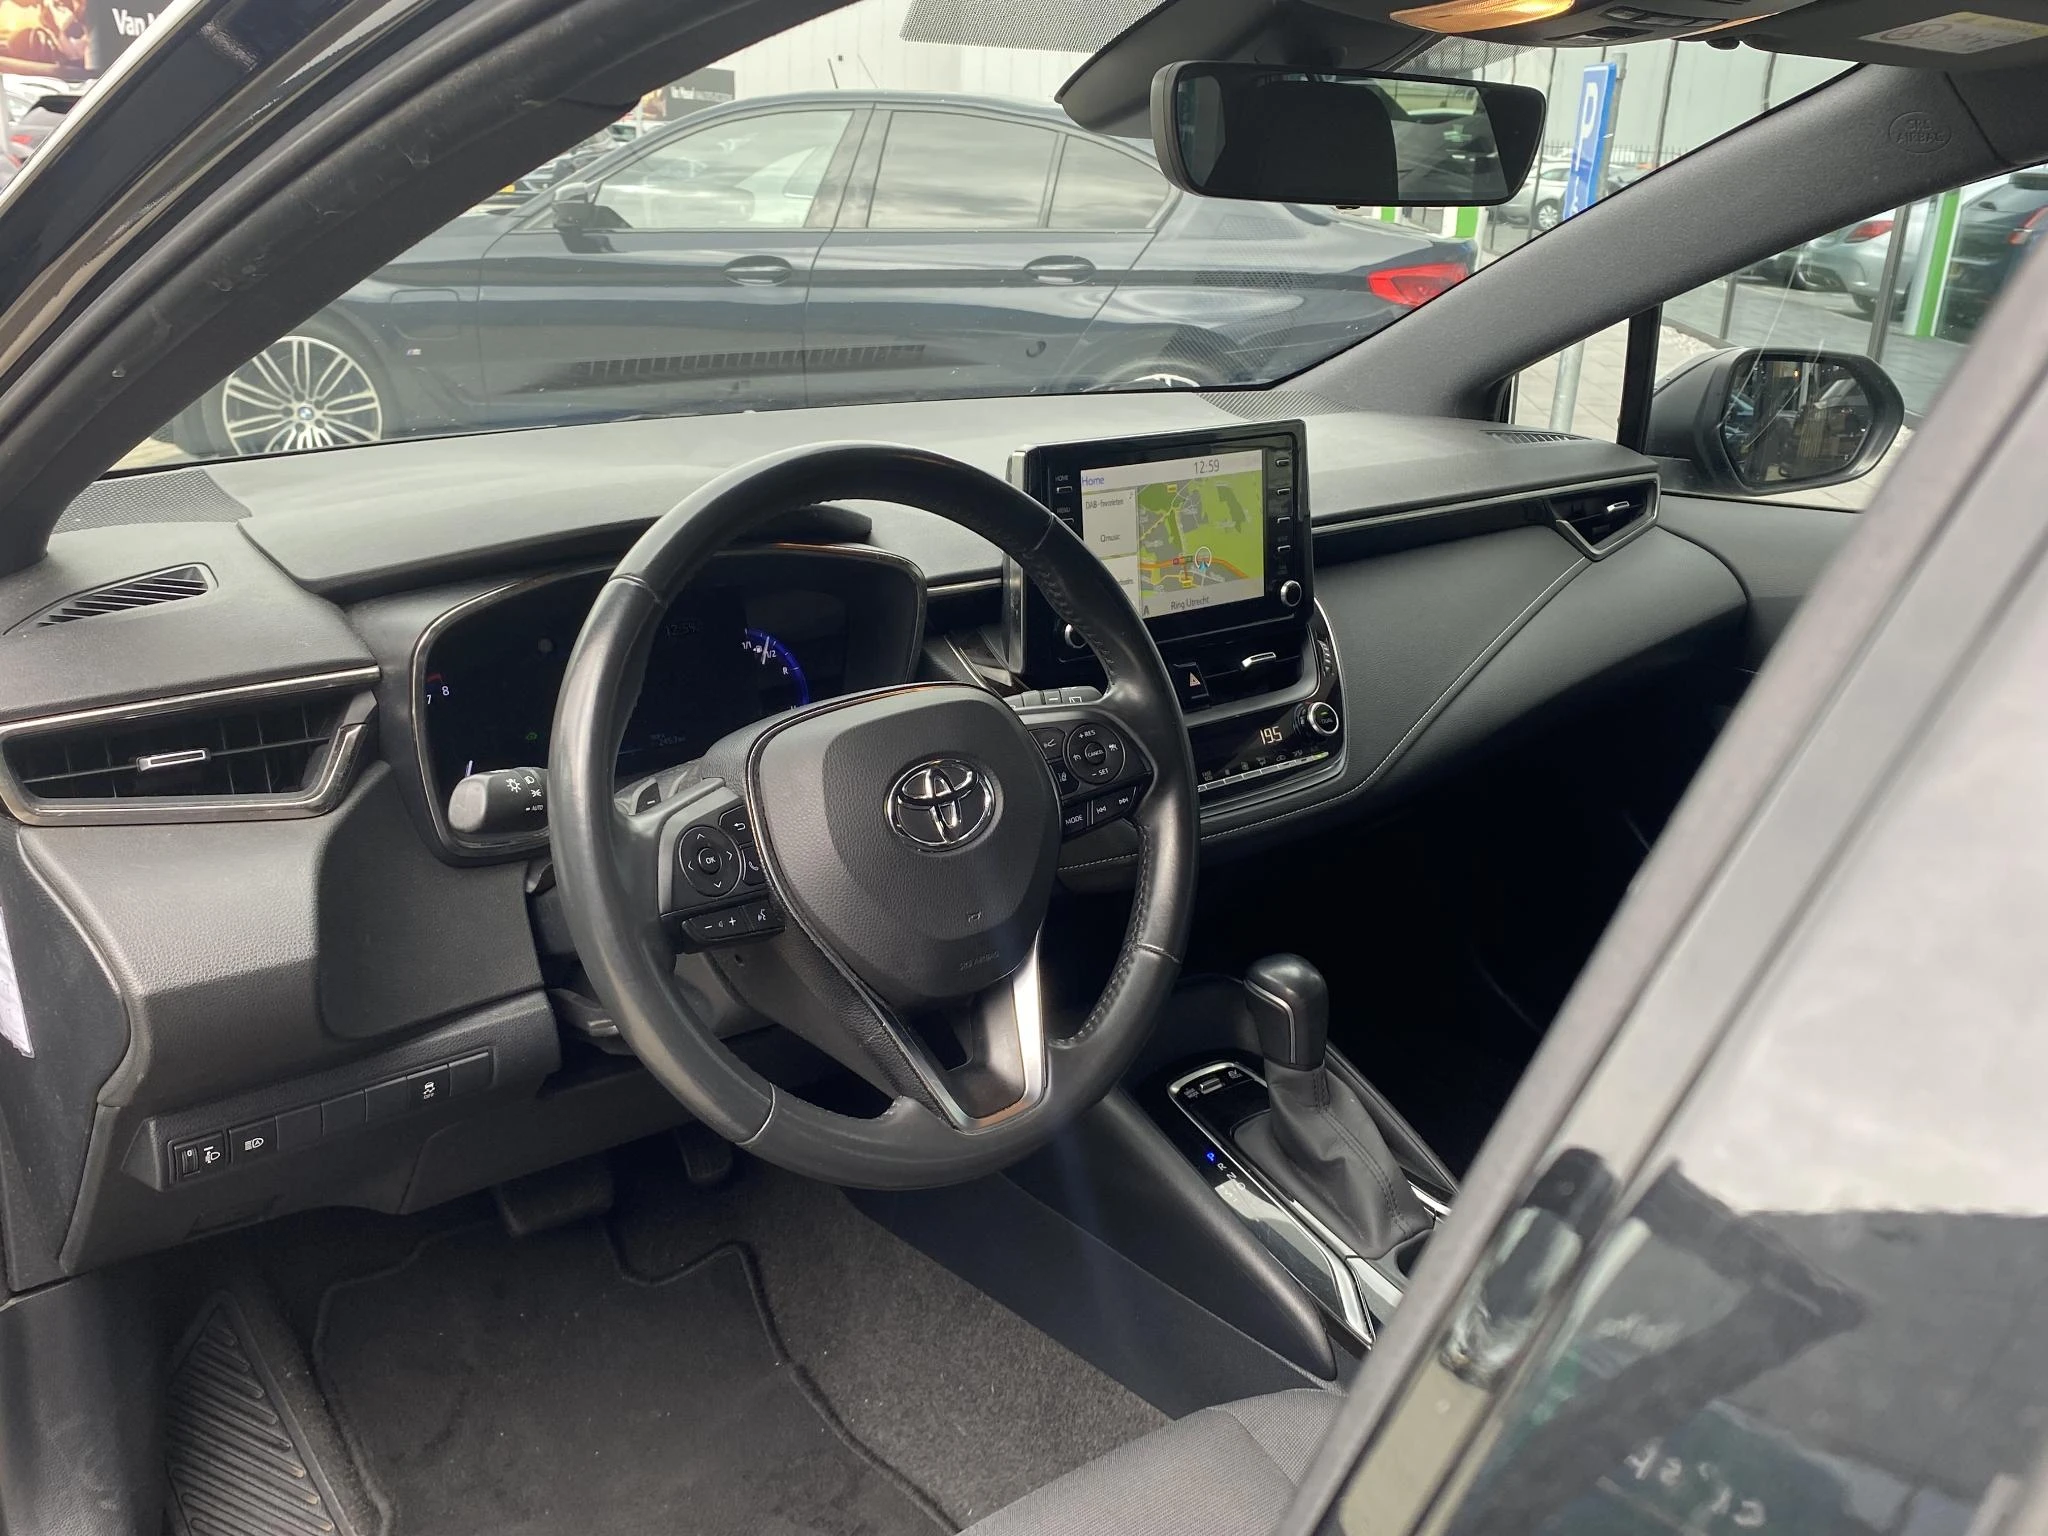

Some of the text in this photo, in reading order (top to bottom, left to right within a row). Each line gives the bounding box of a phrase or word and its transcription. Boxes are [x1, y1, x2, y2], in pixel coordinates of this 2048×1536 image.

[111, 8, 146, 36] Van
[1575, 82, 1599, 172] P
[1194, 459, 1220, 475] 12:59
[1081, 476, 1105, 487] Home
[1170, 601, 1185, 611] Ring
[1187, 596, 1210, 608] Utrecht
[782, 667, 789, 675] R
[441, 685, 450, 696] 8
[426, 694, 432, 705] 7
[1087, 749, 1104, 757] CANCEL
[1098, 767, 1109, 776] SET
[1065, 814, 1083, 825] MODE
[705, 857, 716, 865] OK
[186, 1149, 193, 1157] 0
[1206, 1152, 1215, 1162] P
[1217, 1162, 1227, 1171] R
[1226, 1171, 1237, 1180] N
